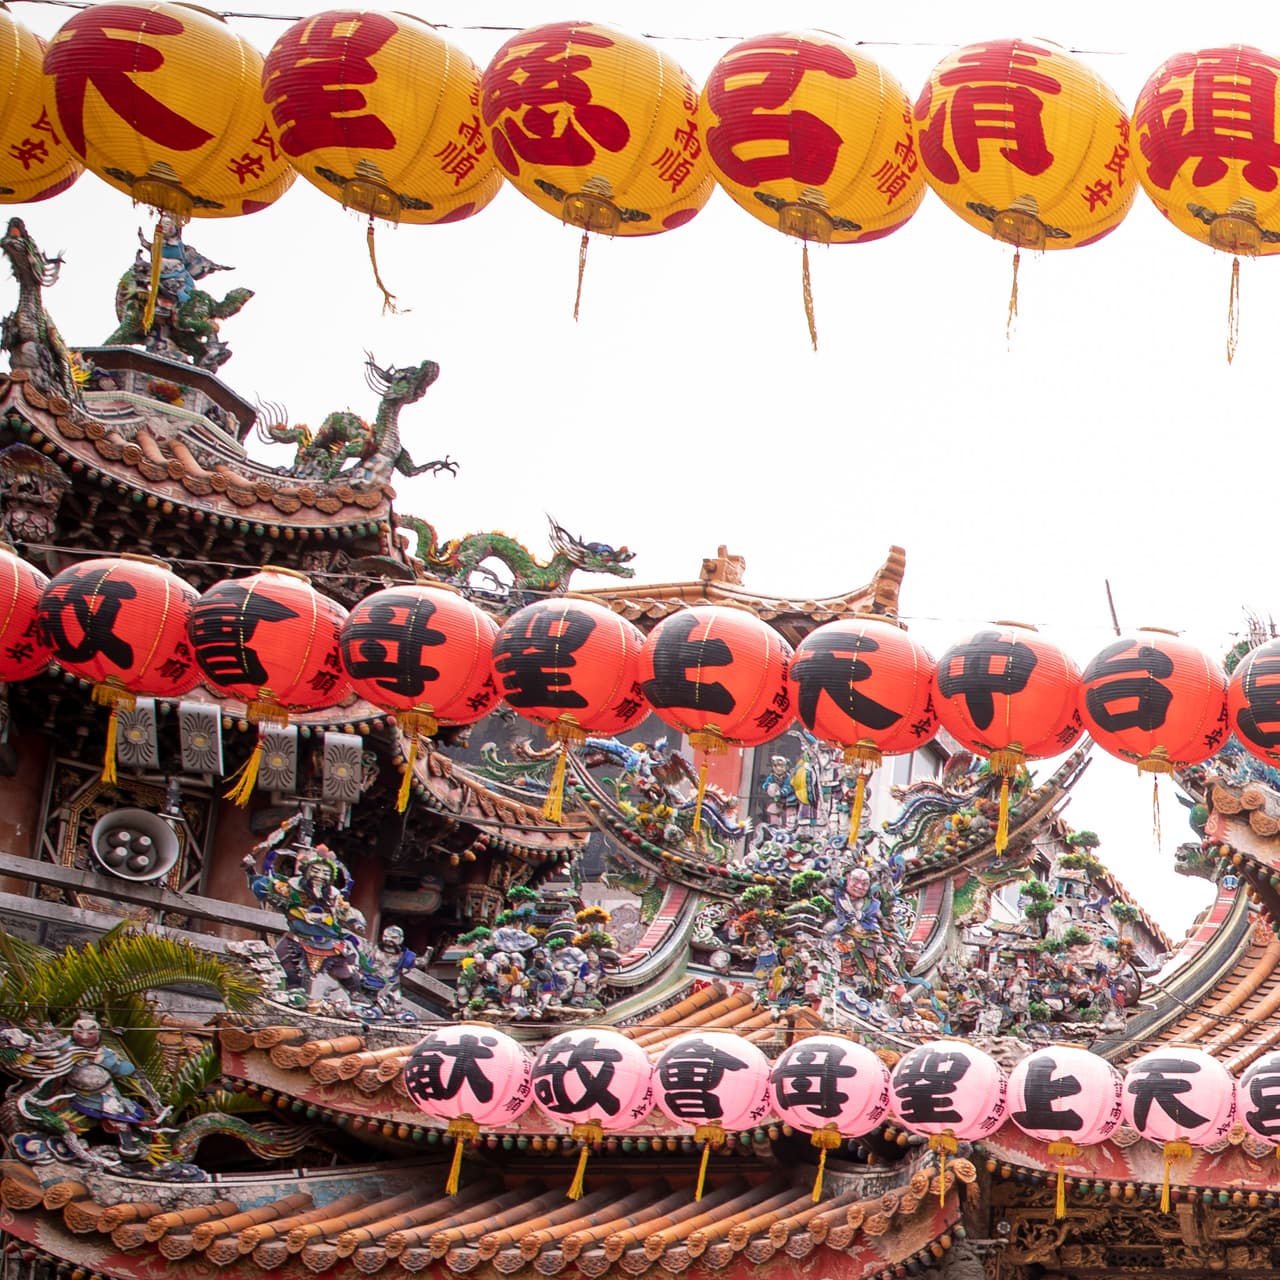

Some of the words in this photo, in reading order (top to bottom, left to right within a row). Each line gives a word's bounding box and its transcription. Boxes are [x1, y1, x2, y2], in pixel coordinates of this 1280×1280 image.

[706, 34, 857, 188] 宮
[914, 38, 1061, 185] 清
[340, 593, 446, 697] 母
[643, 614, 736, 714] 上
[789, 631, 903, 732] 天
[938, 631, 1038, 731] 中
[1083, 639, 1174, 733] 台
[532, 1035, 624, 1117] 敬
[656, 1039, 750, 1120] 會
[774, 1043, 857, 1119] 母
[892, 1047, 970, 1124] 聖
[1003, 1056, 1083, 1130] 上
[1126, 1058, 1211, 1133] 天
